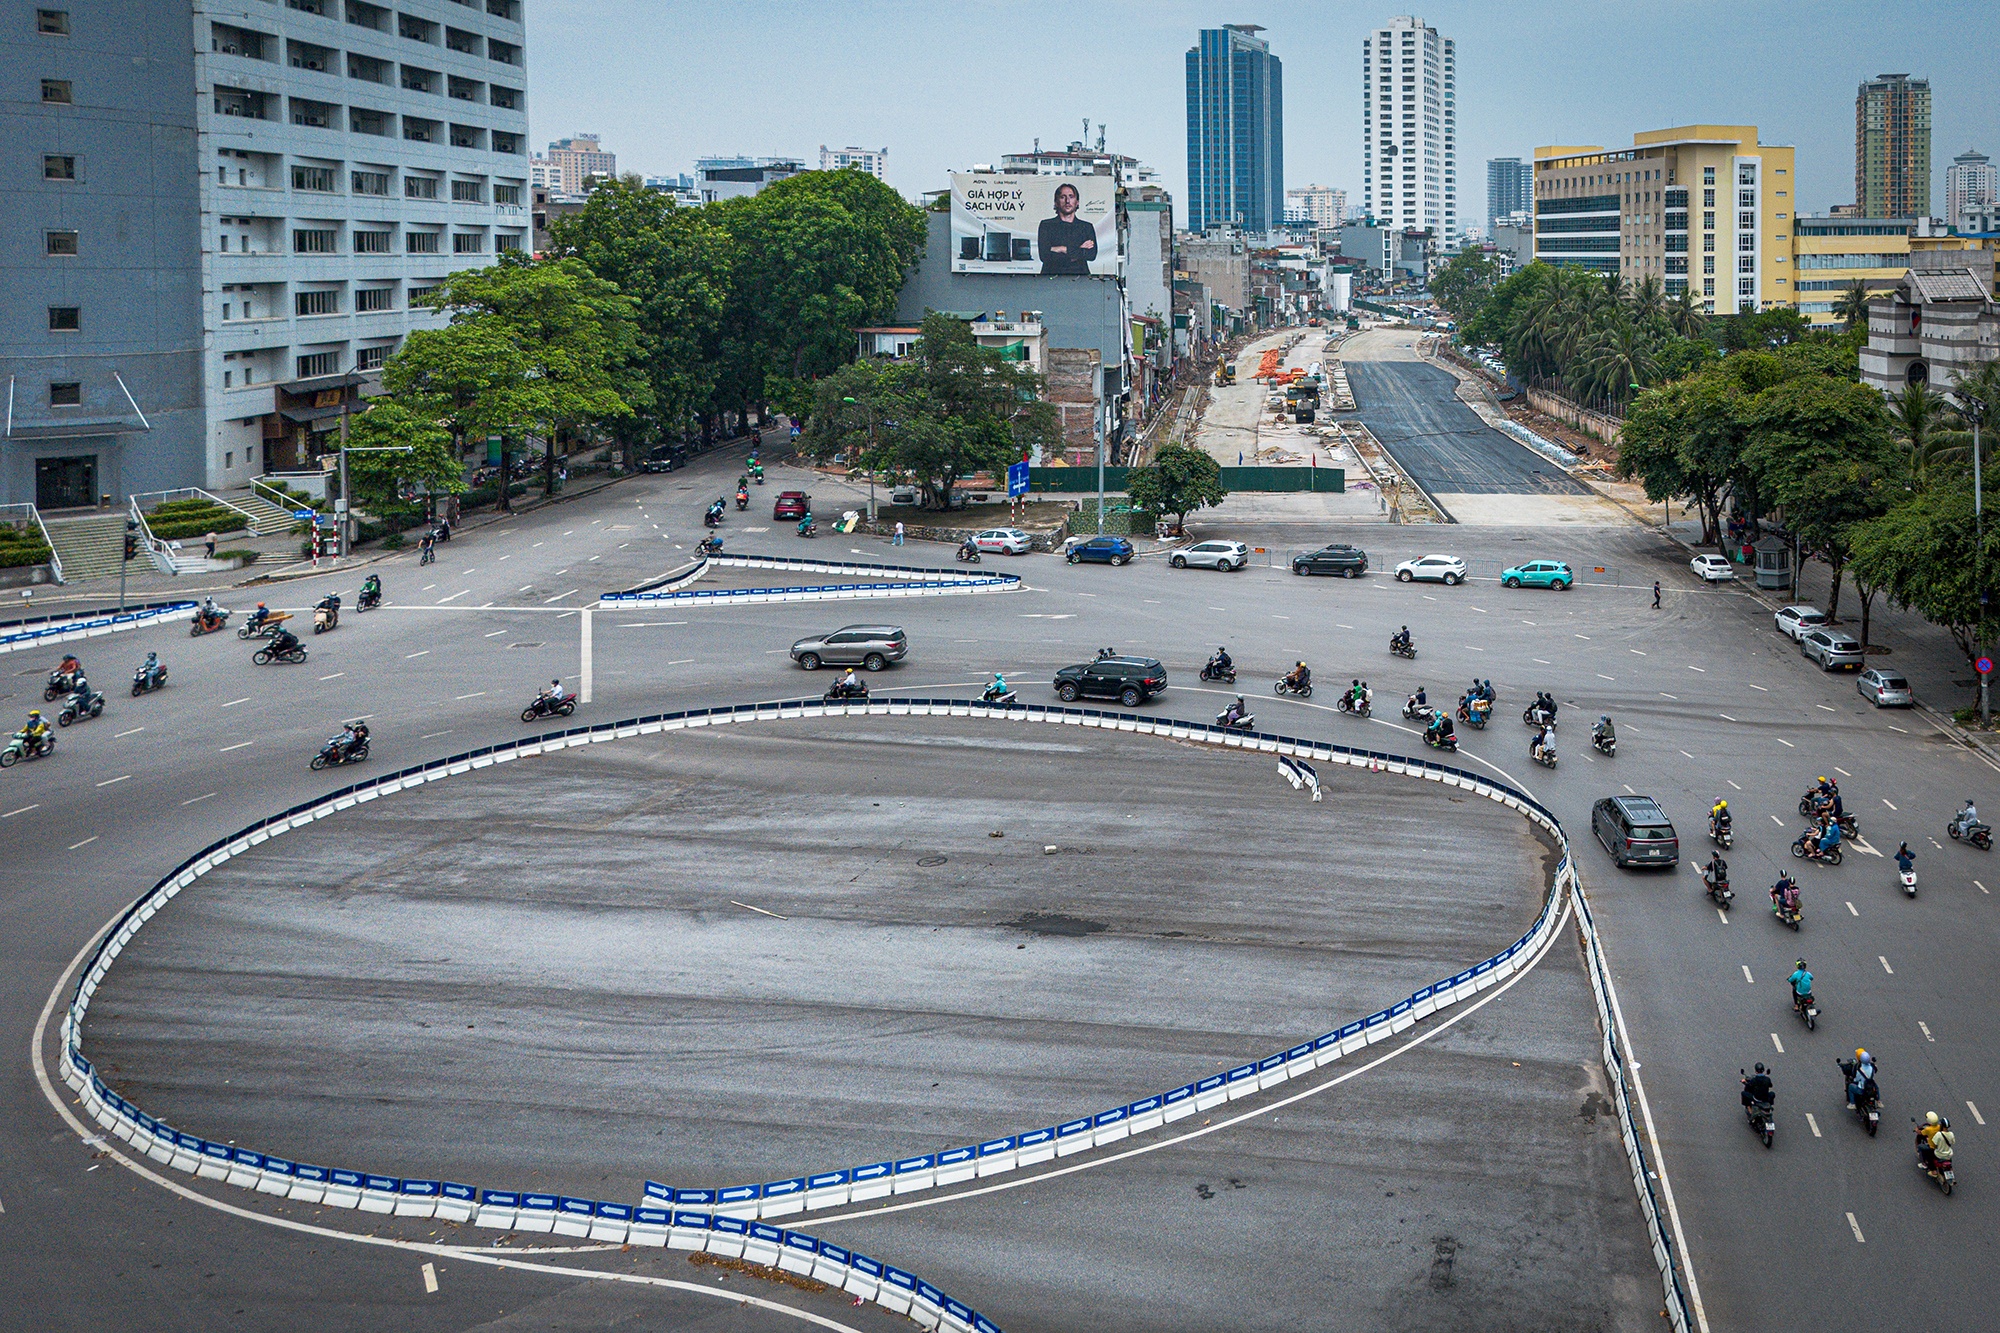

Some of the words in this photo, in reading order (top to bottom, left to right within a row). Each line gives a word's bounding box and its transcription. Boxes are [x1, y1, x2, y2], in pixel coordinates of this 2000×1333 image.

[967, 188, 985, 199] GIÁ
[987, 189, 1009, 201] HỢP
[1011, 189, 1022, 199] LÝ
[965, 201, 992, 212] SẠCH
[994, 200, 1016, 211] VỪA
[1018, 201, 1025, 211] Ý
